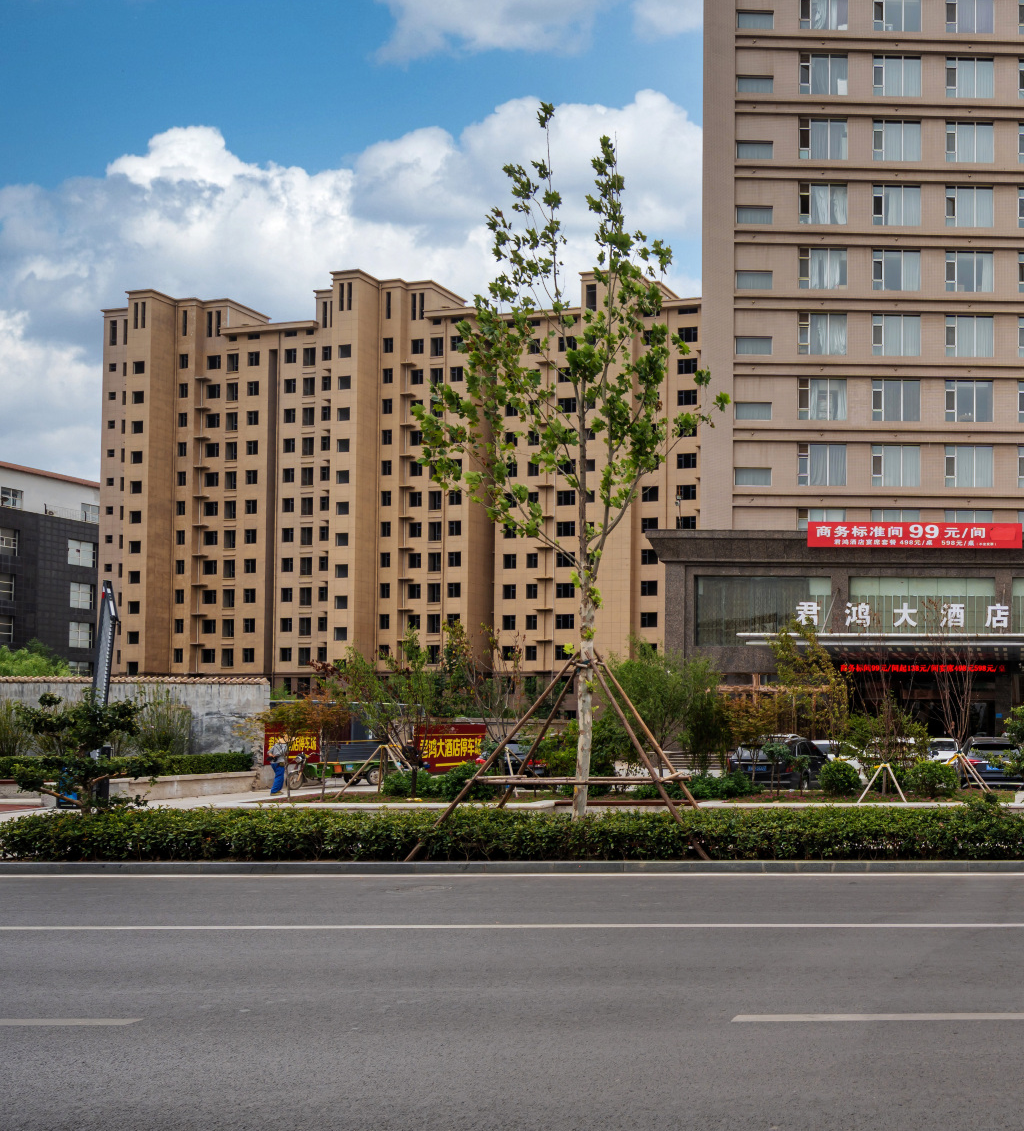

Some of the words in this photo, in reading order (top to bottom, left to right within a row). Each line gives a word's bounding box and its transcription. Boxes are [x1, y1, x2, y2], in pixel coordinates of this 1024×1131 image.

[796, 601, 1010, 628] 君鸿大酒店
